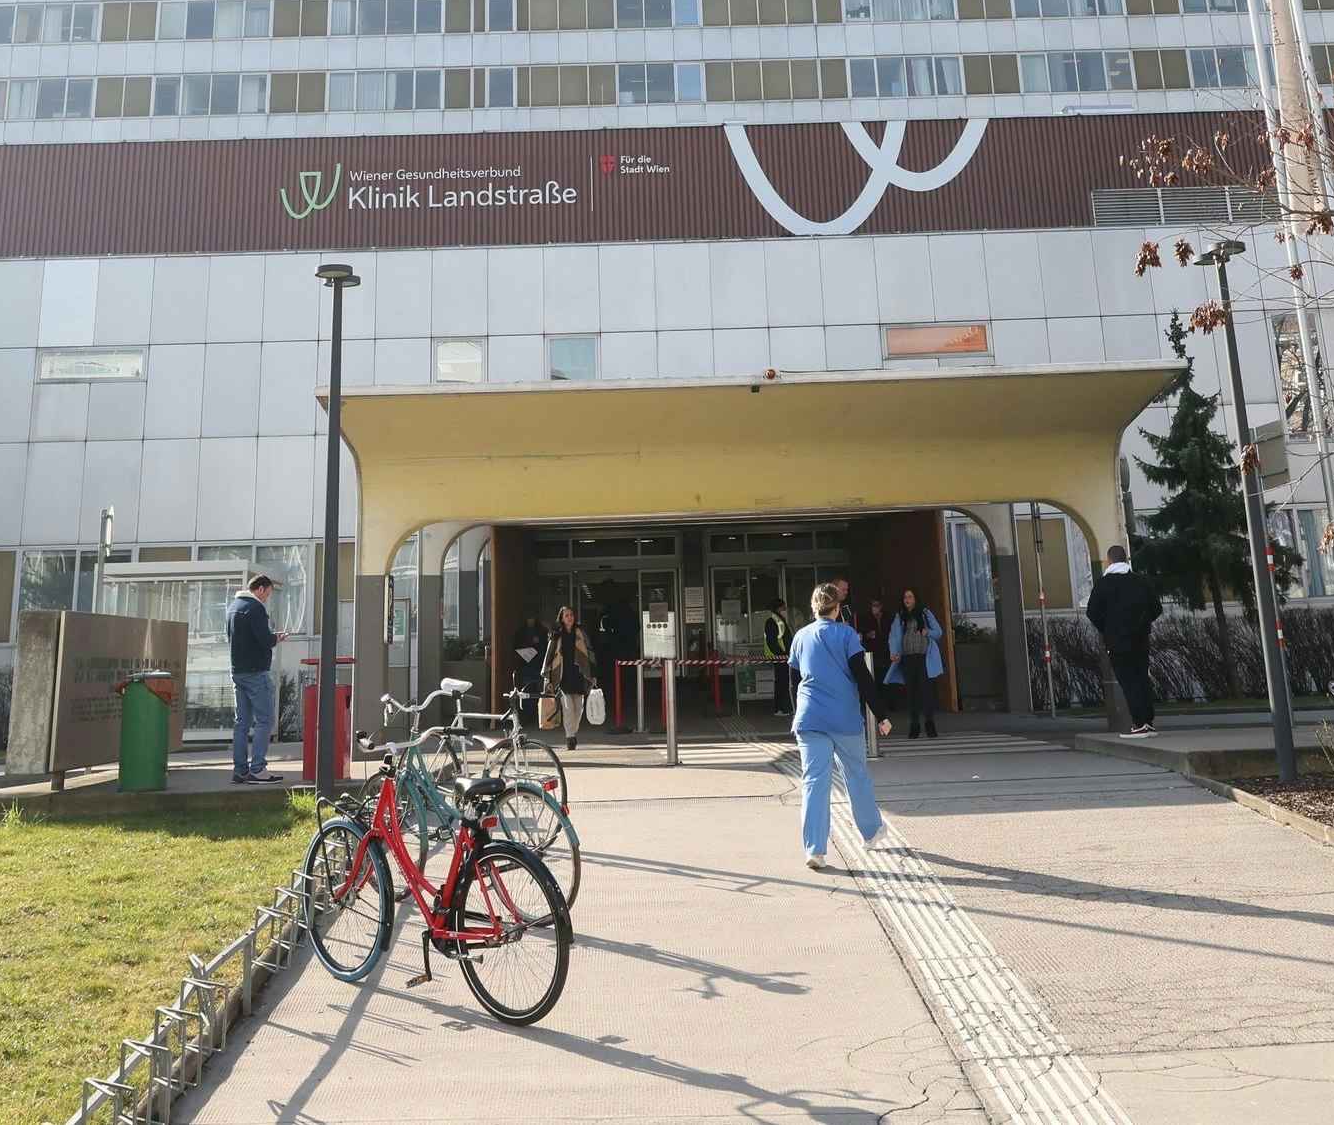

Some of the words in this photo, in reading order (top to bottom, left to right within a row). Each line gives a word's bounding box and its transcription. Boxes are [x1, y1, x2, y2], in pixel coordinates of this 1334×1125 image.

[620, 155, 635, 164] Für
[637, 155, 652, 163] die
[350, 170, 393, 181] Wiener
[396, 166, 521, 180] Gesundheitsverbund
[620, 165, 644, 174] Stadt
[647, 164, 670, 173] Wien
[348, 184, 420, 210] Klinik
[428, 180, 577, 208] Landstraße
